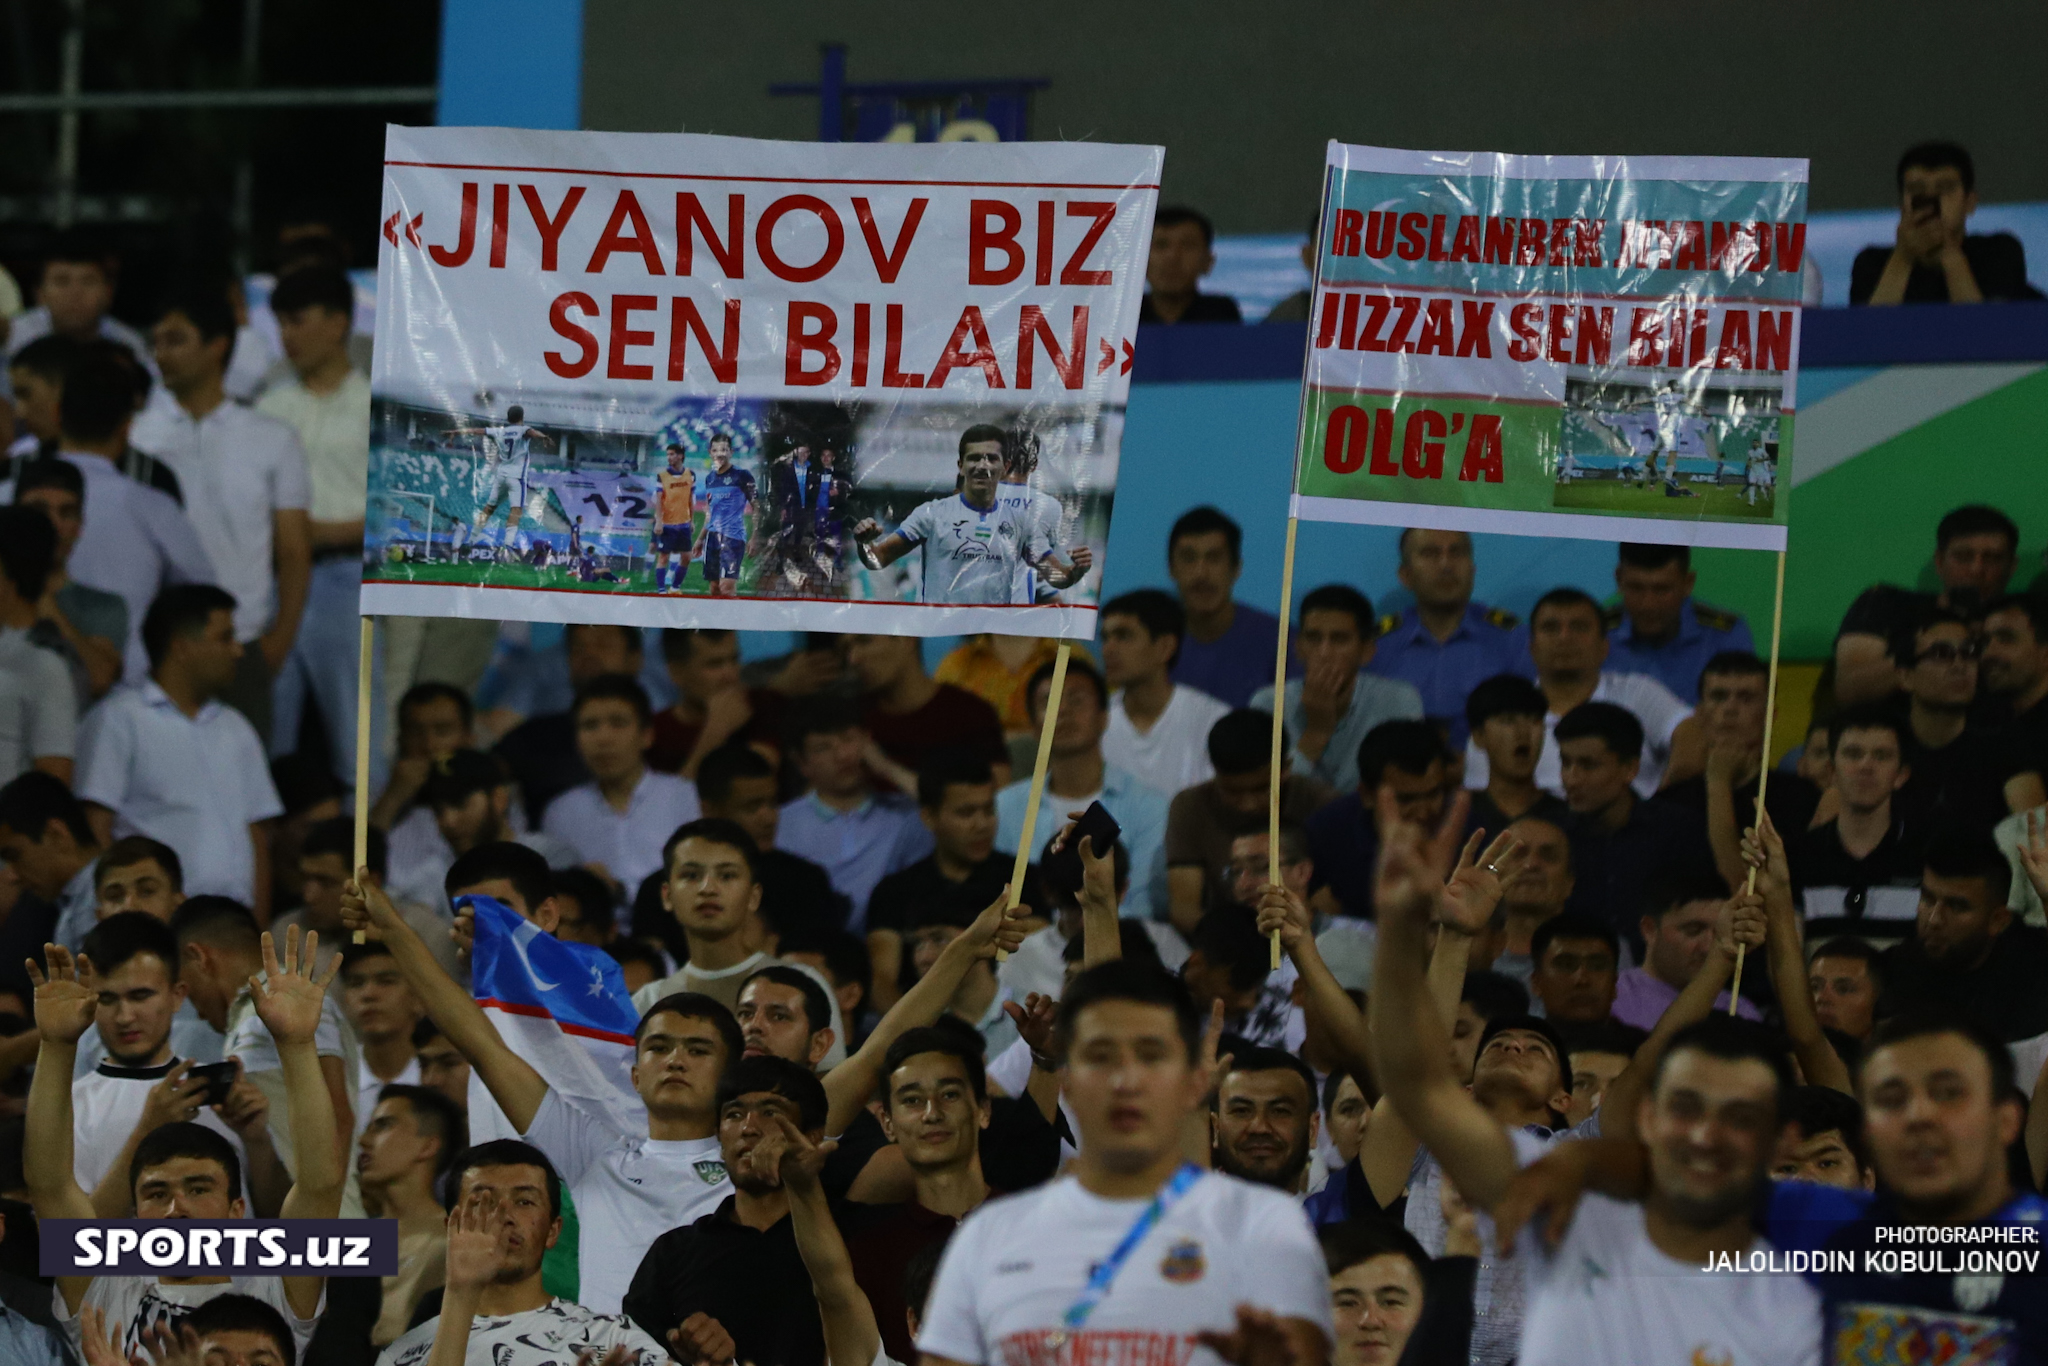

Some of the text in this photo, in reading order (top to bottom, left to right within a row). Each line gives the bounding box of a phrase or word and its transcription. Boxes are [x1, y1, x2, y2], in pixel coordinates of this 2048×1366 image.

[968, 199, 1117, 286] BIZ
[1331, 208, 1807, 273] RUSLANBEK JIYANOV
[544, 291, 741, 384] SEN
[1315, 291, 1793, 371] JIZZAX SEN BILAN
[582, 493, 656, 520] 12
